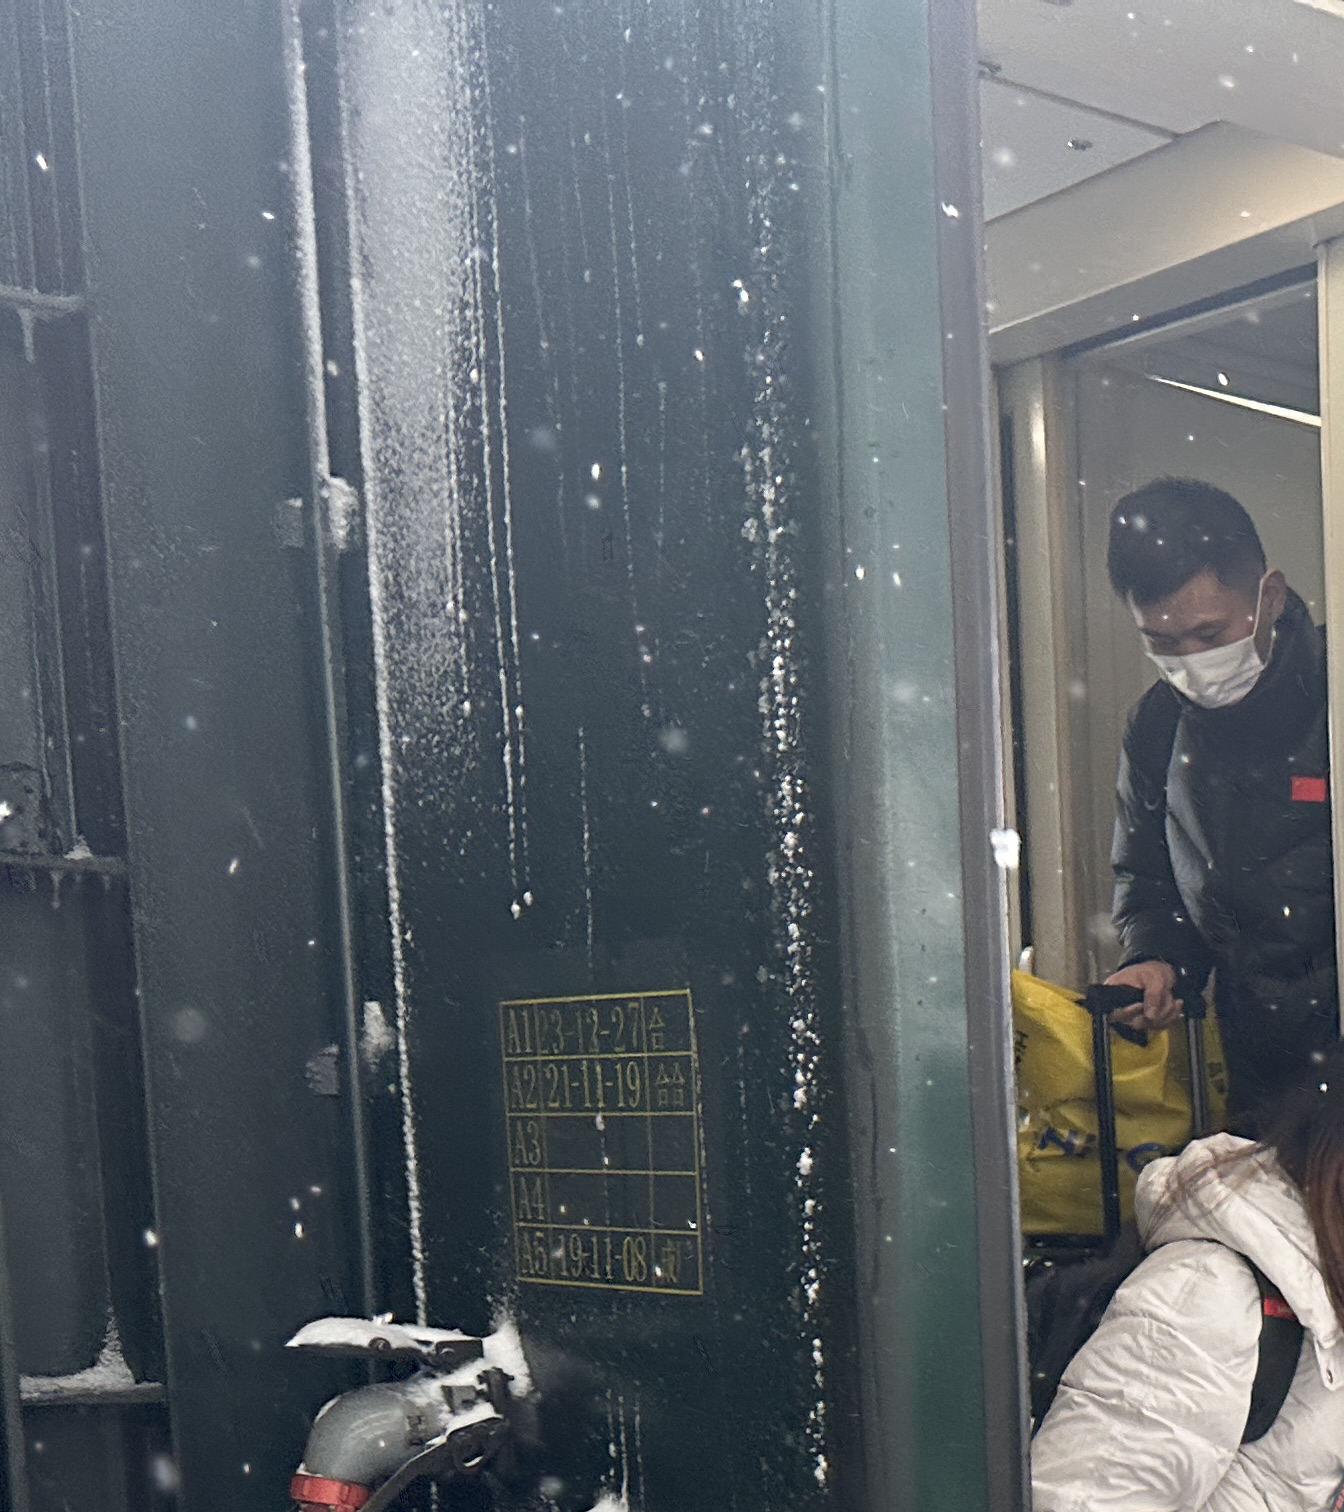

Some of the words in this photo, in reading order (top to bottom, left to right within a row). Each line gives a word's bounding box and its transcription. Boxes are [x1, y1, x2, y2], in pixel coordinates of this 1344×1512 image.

[508, 1008, 533, 1053] A1
[511, 1064, 537, 1109] A2
[545, 1060, 640, 1107] 21-11-19
[515, 1121, 541, 1165] A3
[518, 1177, 544, 1220] A4
[521, 1231, 547, 1275] A5
[558, 1233, 647, 1282] 19-11-08
